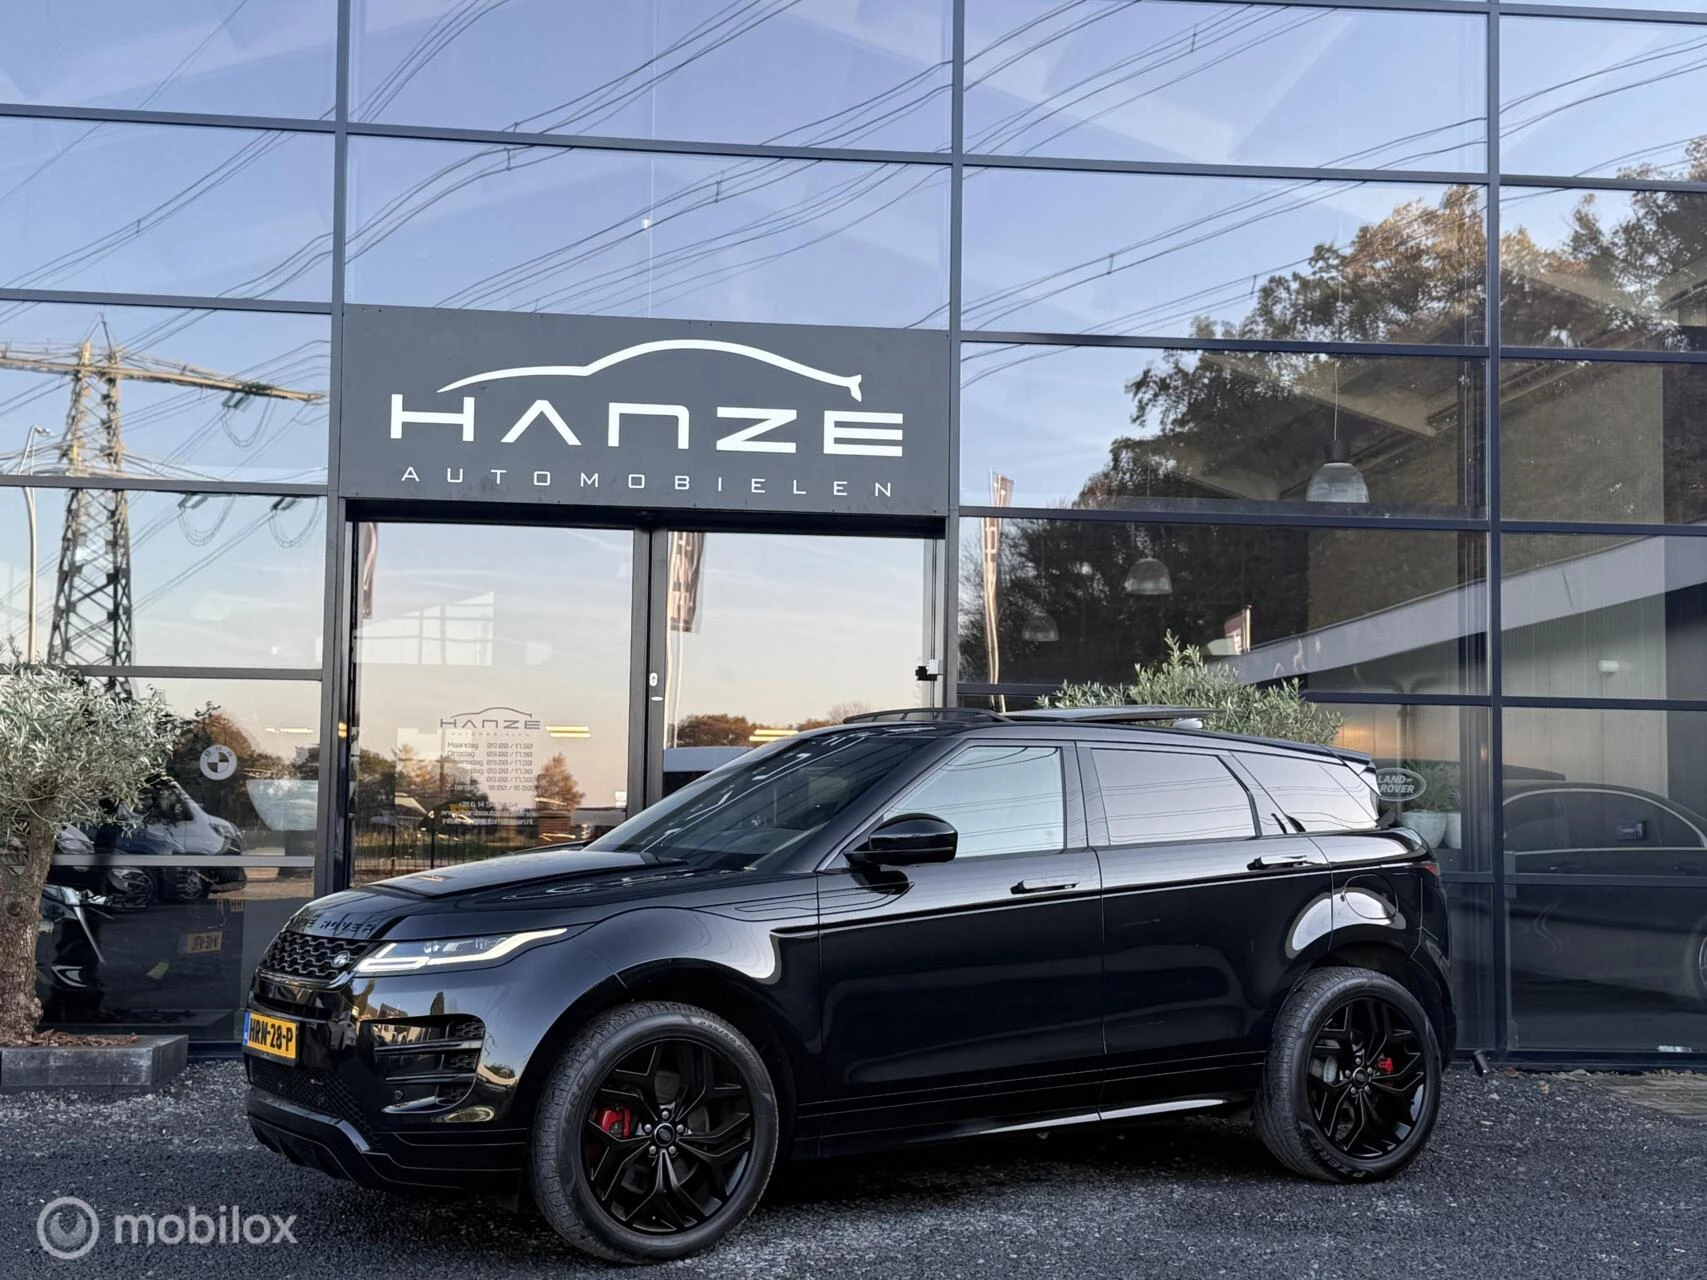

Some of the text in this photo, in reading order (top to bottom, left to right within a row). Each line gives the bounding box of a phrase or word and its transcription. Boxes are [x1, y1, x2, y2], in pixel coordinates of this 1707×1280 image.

[390, 394, 904, 457] HANZE
[401, 465, 892, 497] AUTOMOBIELEN
[440, 718, 541, 730] HANZE
[1377, 775, 1406, 784] LAND
[1380, 784, 1415, 794] ROVER
[249, 1018, 294, 1053] HRN-28-P
